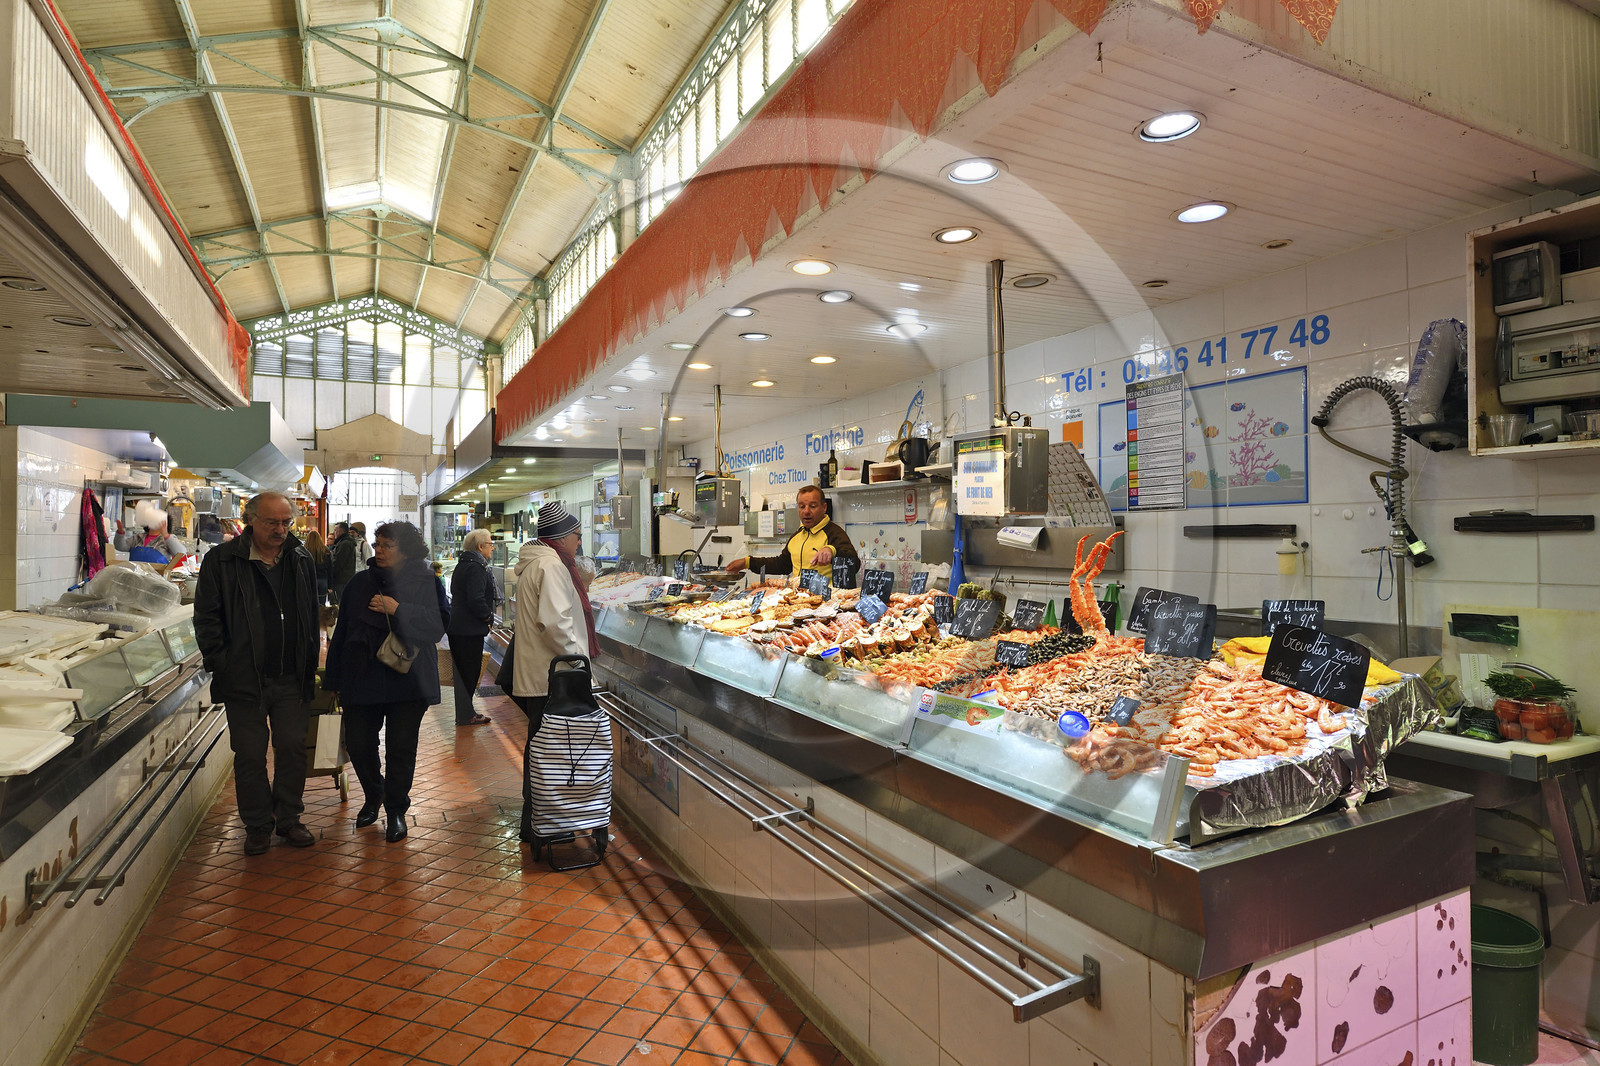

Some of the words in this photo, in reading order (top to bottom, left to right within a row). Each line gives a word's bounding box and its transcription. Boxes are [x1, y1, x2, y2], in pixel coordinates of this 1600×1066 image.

[1061, 367, 1092, 393] Tél
[1122, 358, 1151, 384] 05
[1158, 346, 1189, 374] 46
[1197, 336, 1228, 367] 41
[1241, 325, 1278, 360] 77
[1289, 314, 1331, 348] 48
[723, 441, 785, 471] Poissonnerie
[805, 425, 864, 456] Fontaine
[768, 470, 787, 486] Chez
[787, 468, 807, 483] Titou
[1283, 600, 1291, 613] de
[1294, 600, 1319, 613] haddock
[1331, 648, 1363, 666] roses
